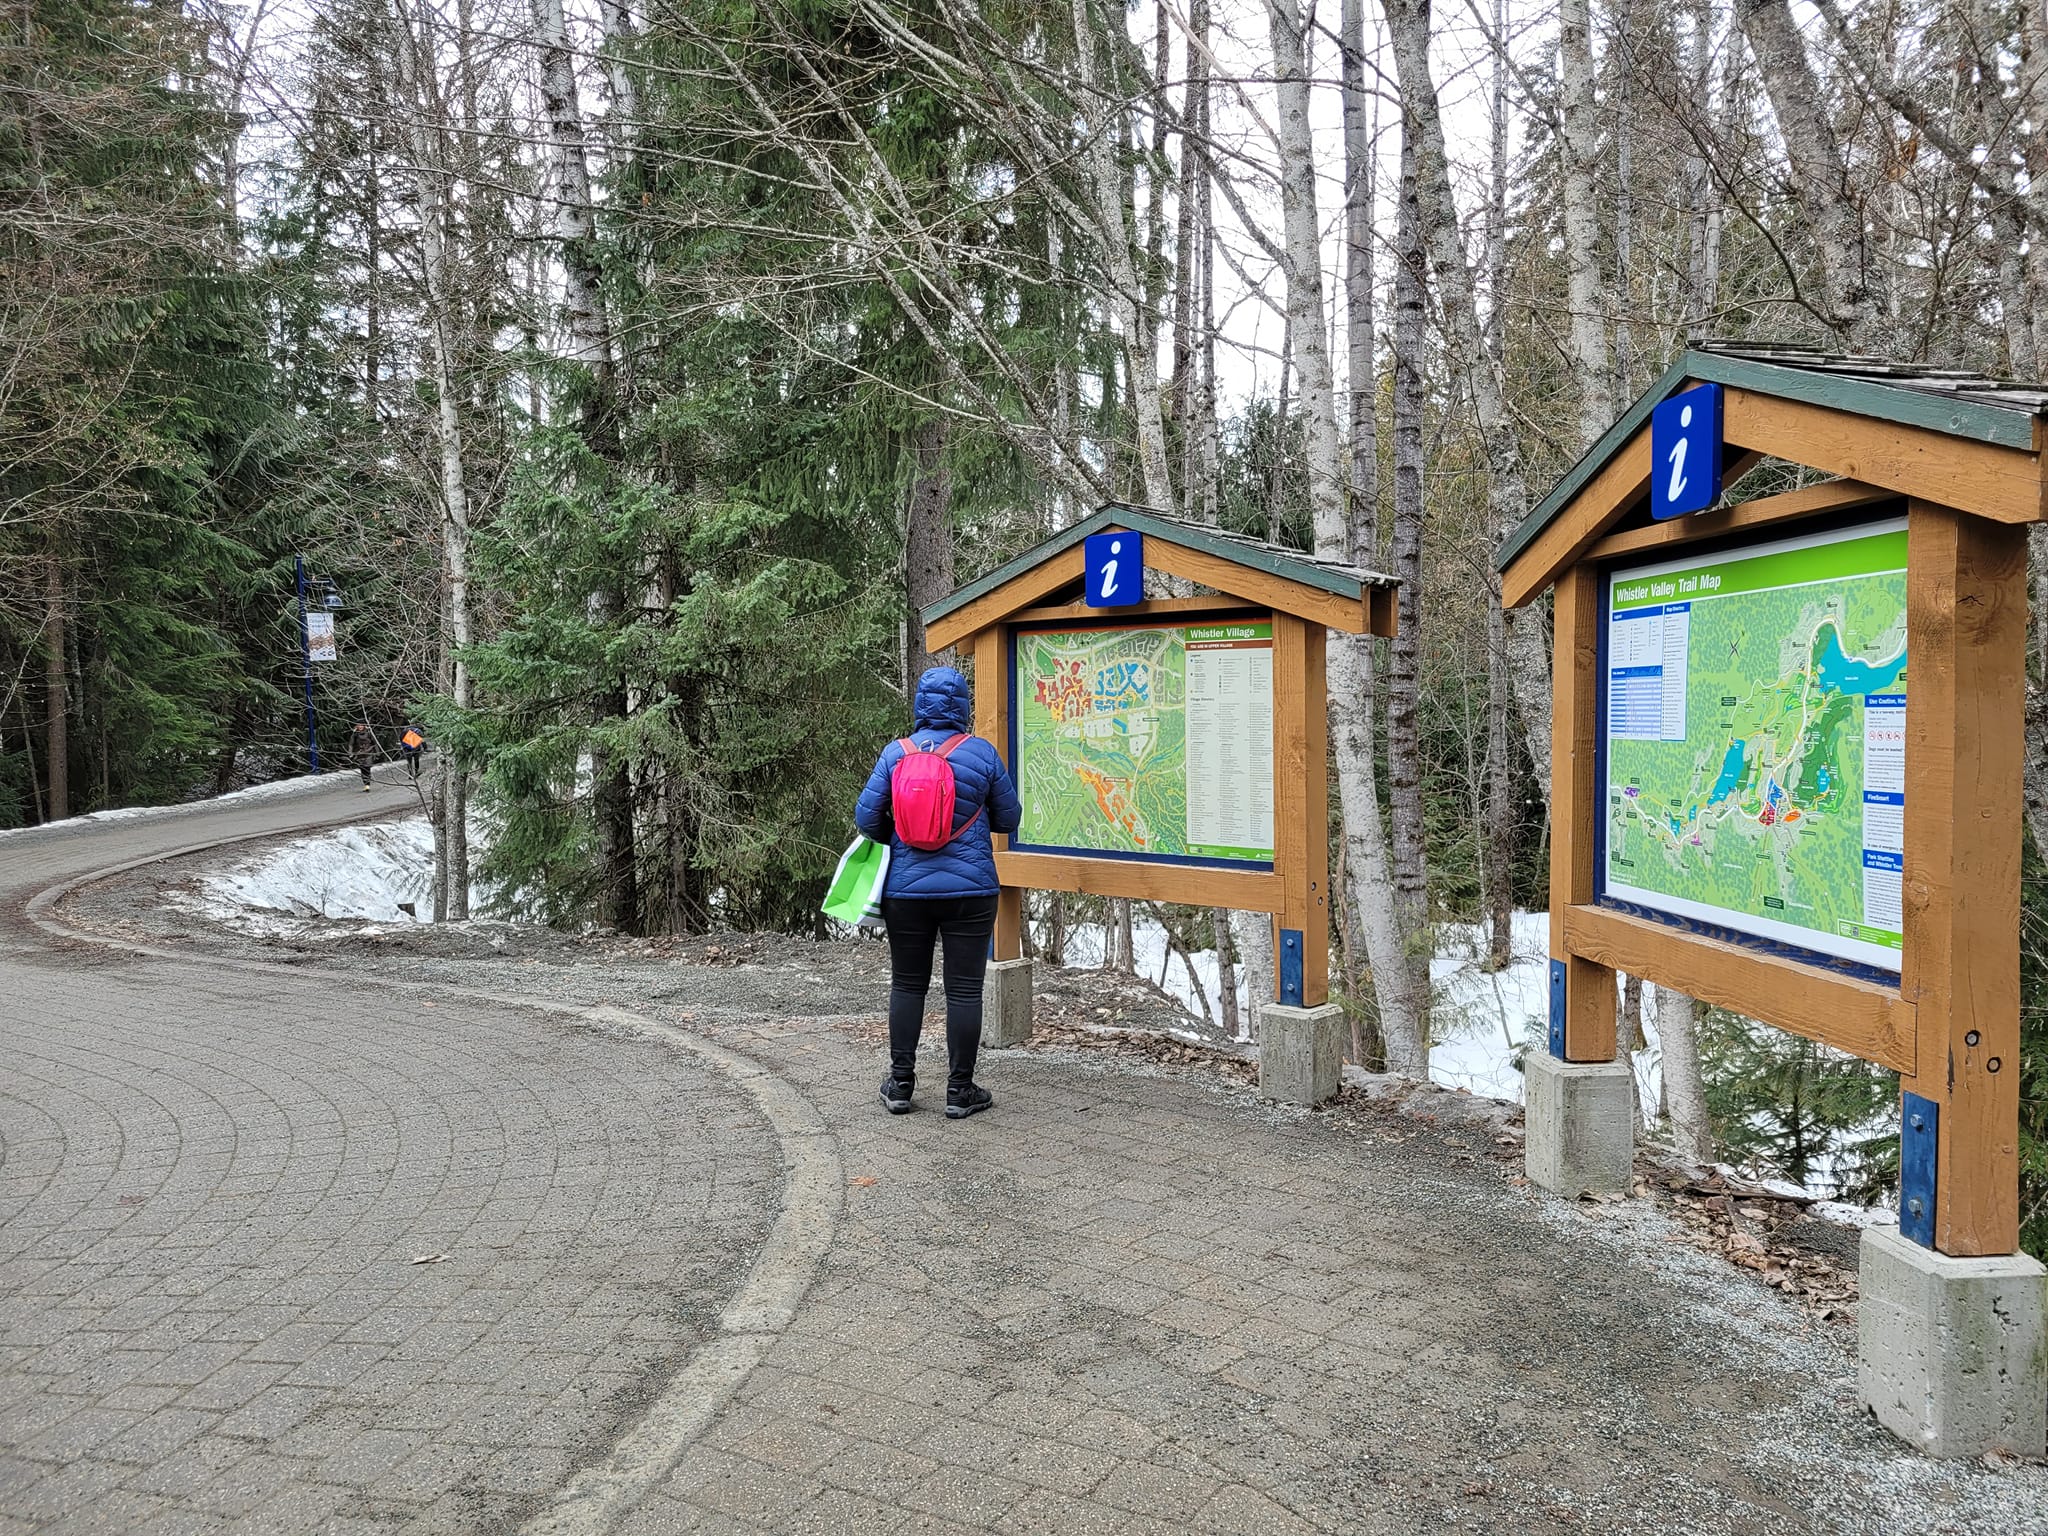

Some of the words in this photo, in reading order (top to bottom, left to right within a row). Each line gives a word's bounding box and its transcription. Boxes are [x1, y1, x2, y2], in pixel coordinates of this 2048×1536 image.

[1668, 405, 1692, 502] i
[1101, 541, 1121, 598] i
[1616, 586, 1648, 602] Whistler
[1651, 581, 1675, 597] Valley
[1679, 576, 1697, 593] Trail
[1700, 574, 1721, 590] Map
[1190, 629, 1224, 639] Whistler
[1226, 628, 1255, 638] Village
